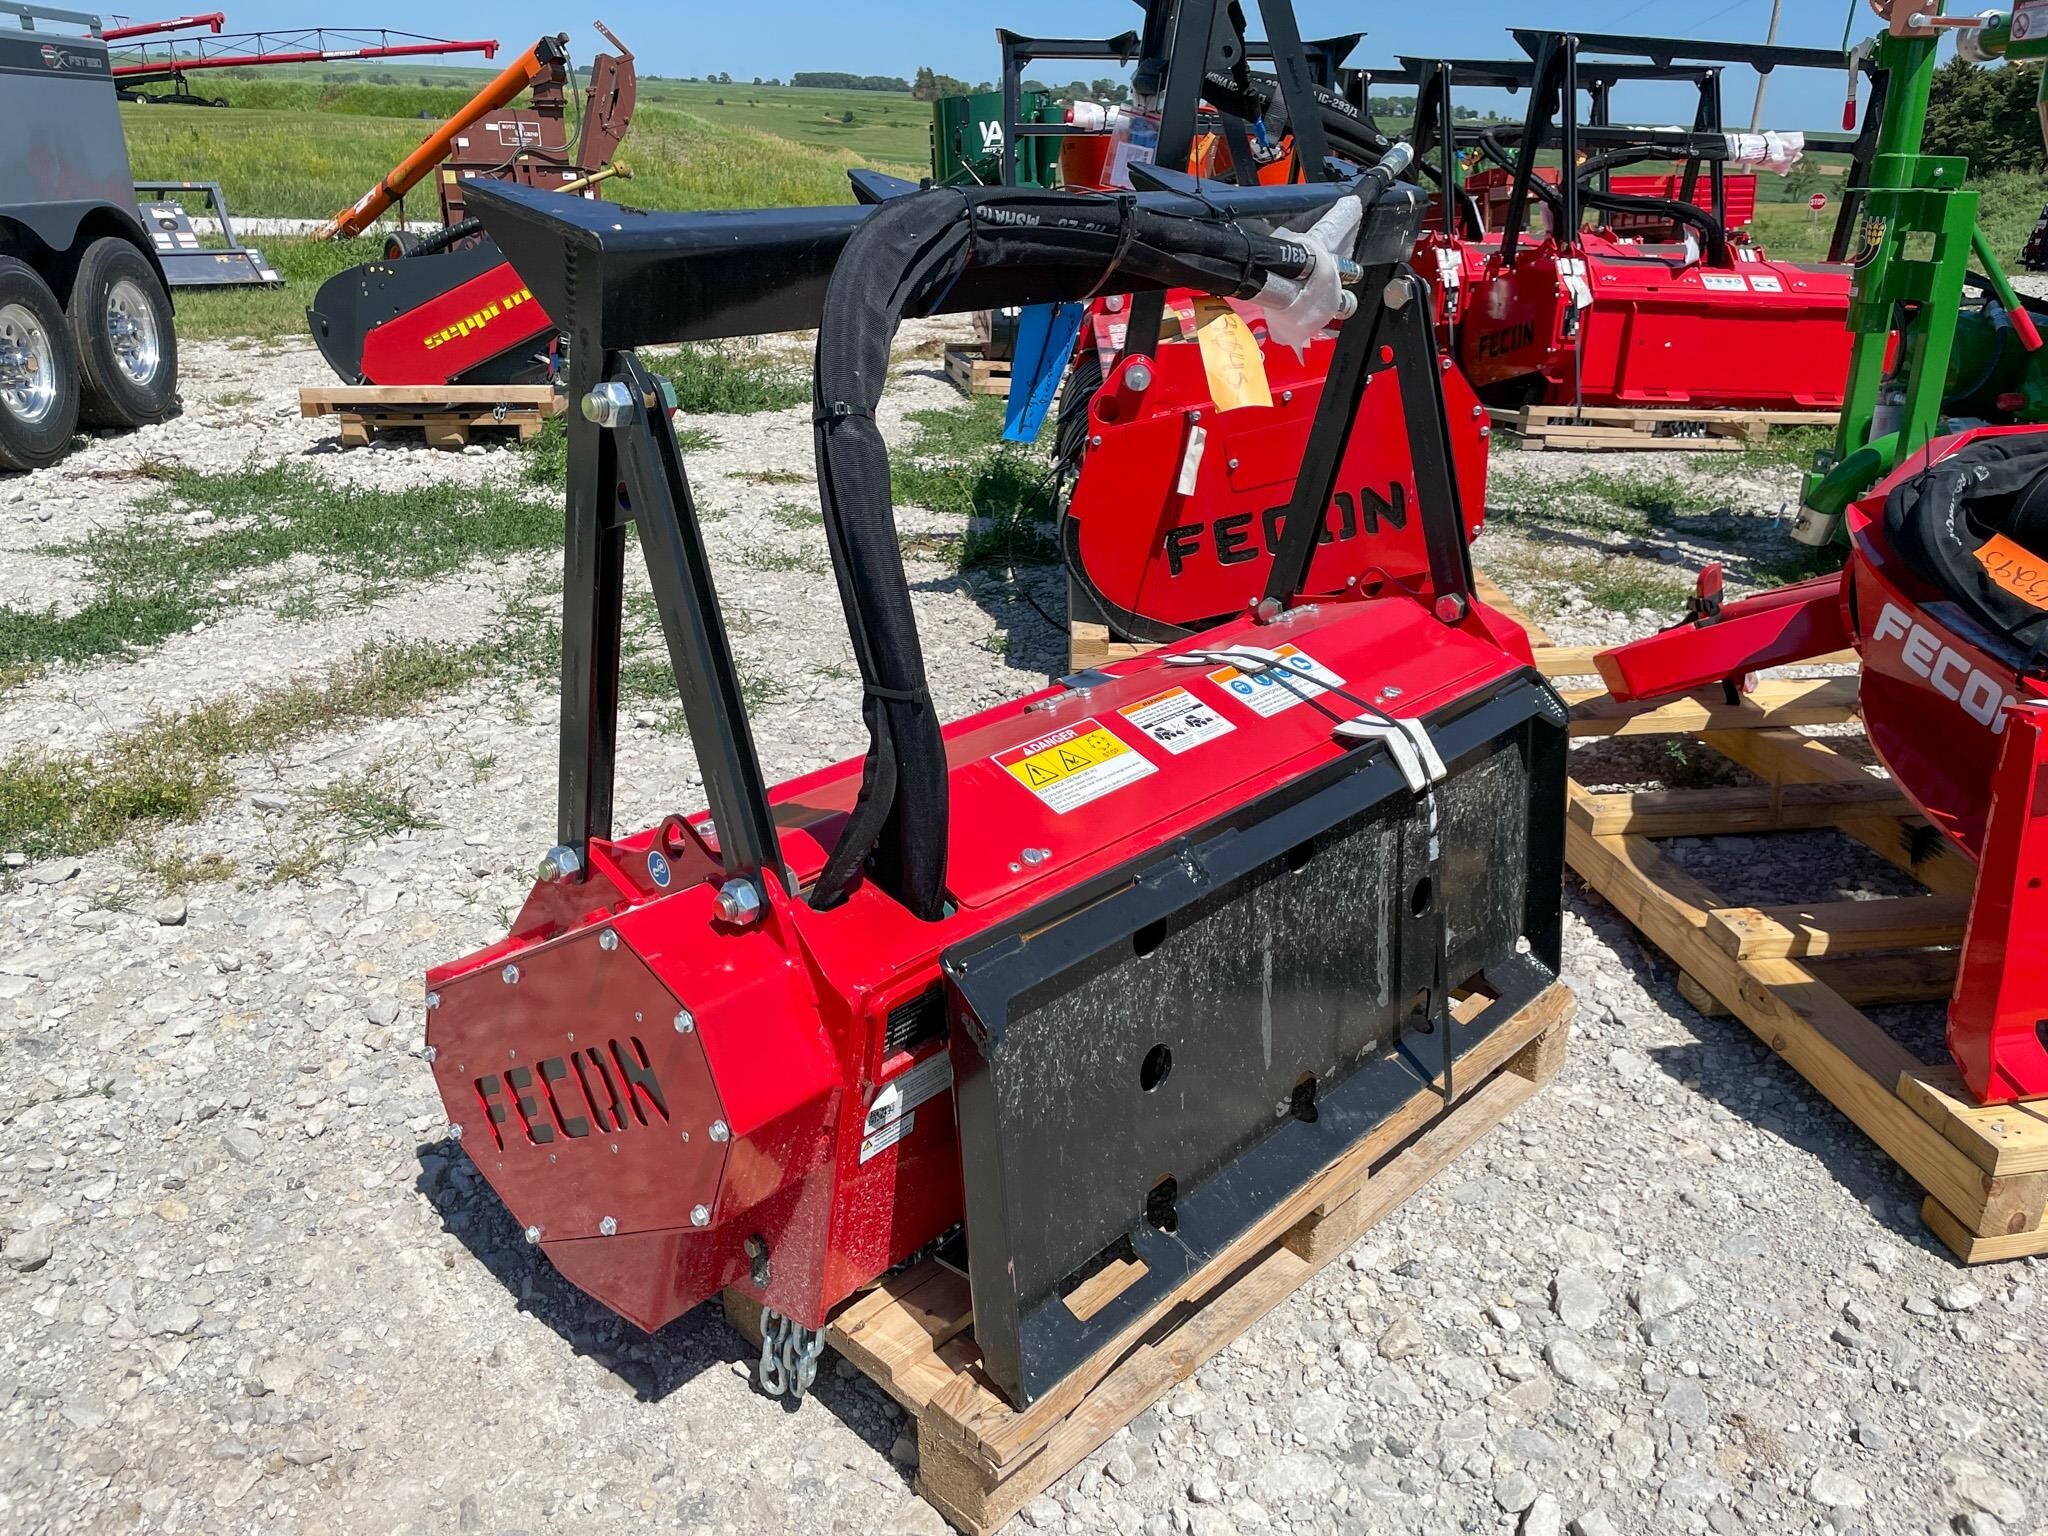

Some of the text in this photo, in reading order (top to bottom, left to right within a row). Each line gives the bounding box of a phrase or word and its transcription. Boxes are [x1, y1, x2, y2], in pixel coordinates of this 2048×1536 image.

[1204, 71, 1228, 88] MSHA
[1317, 92, 1358, 118] IC-293/1
[1809, 198, 1826, 206] STOP
[423, 301, 501, 350] seppi
[1478, 319, 1536, 362] FECON
[1029, 729, 1078, 752] DANGER
[1101, 747, 1121, 757] STOP
[473, 1036, 670, 1152] FECON
